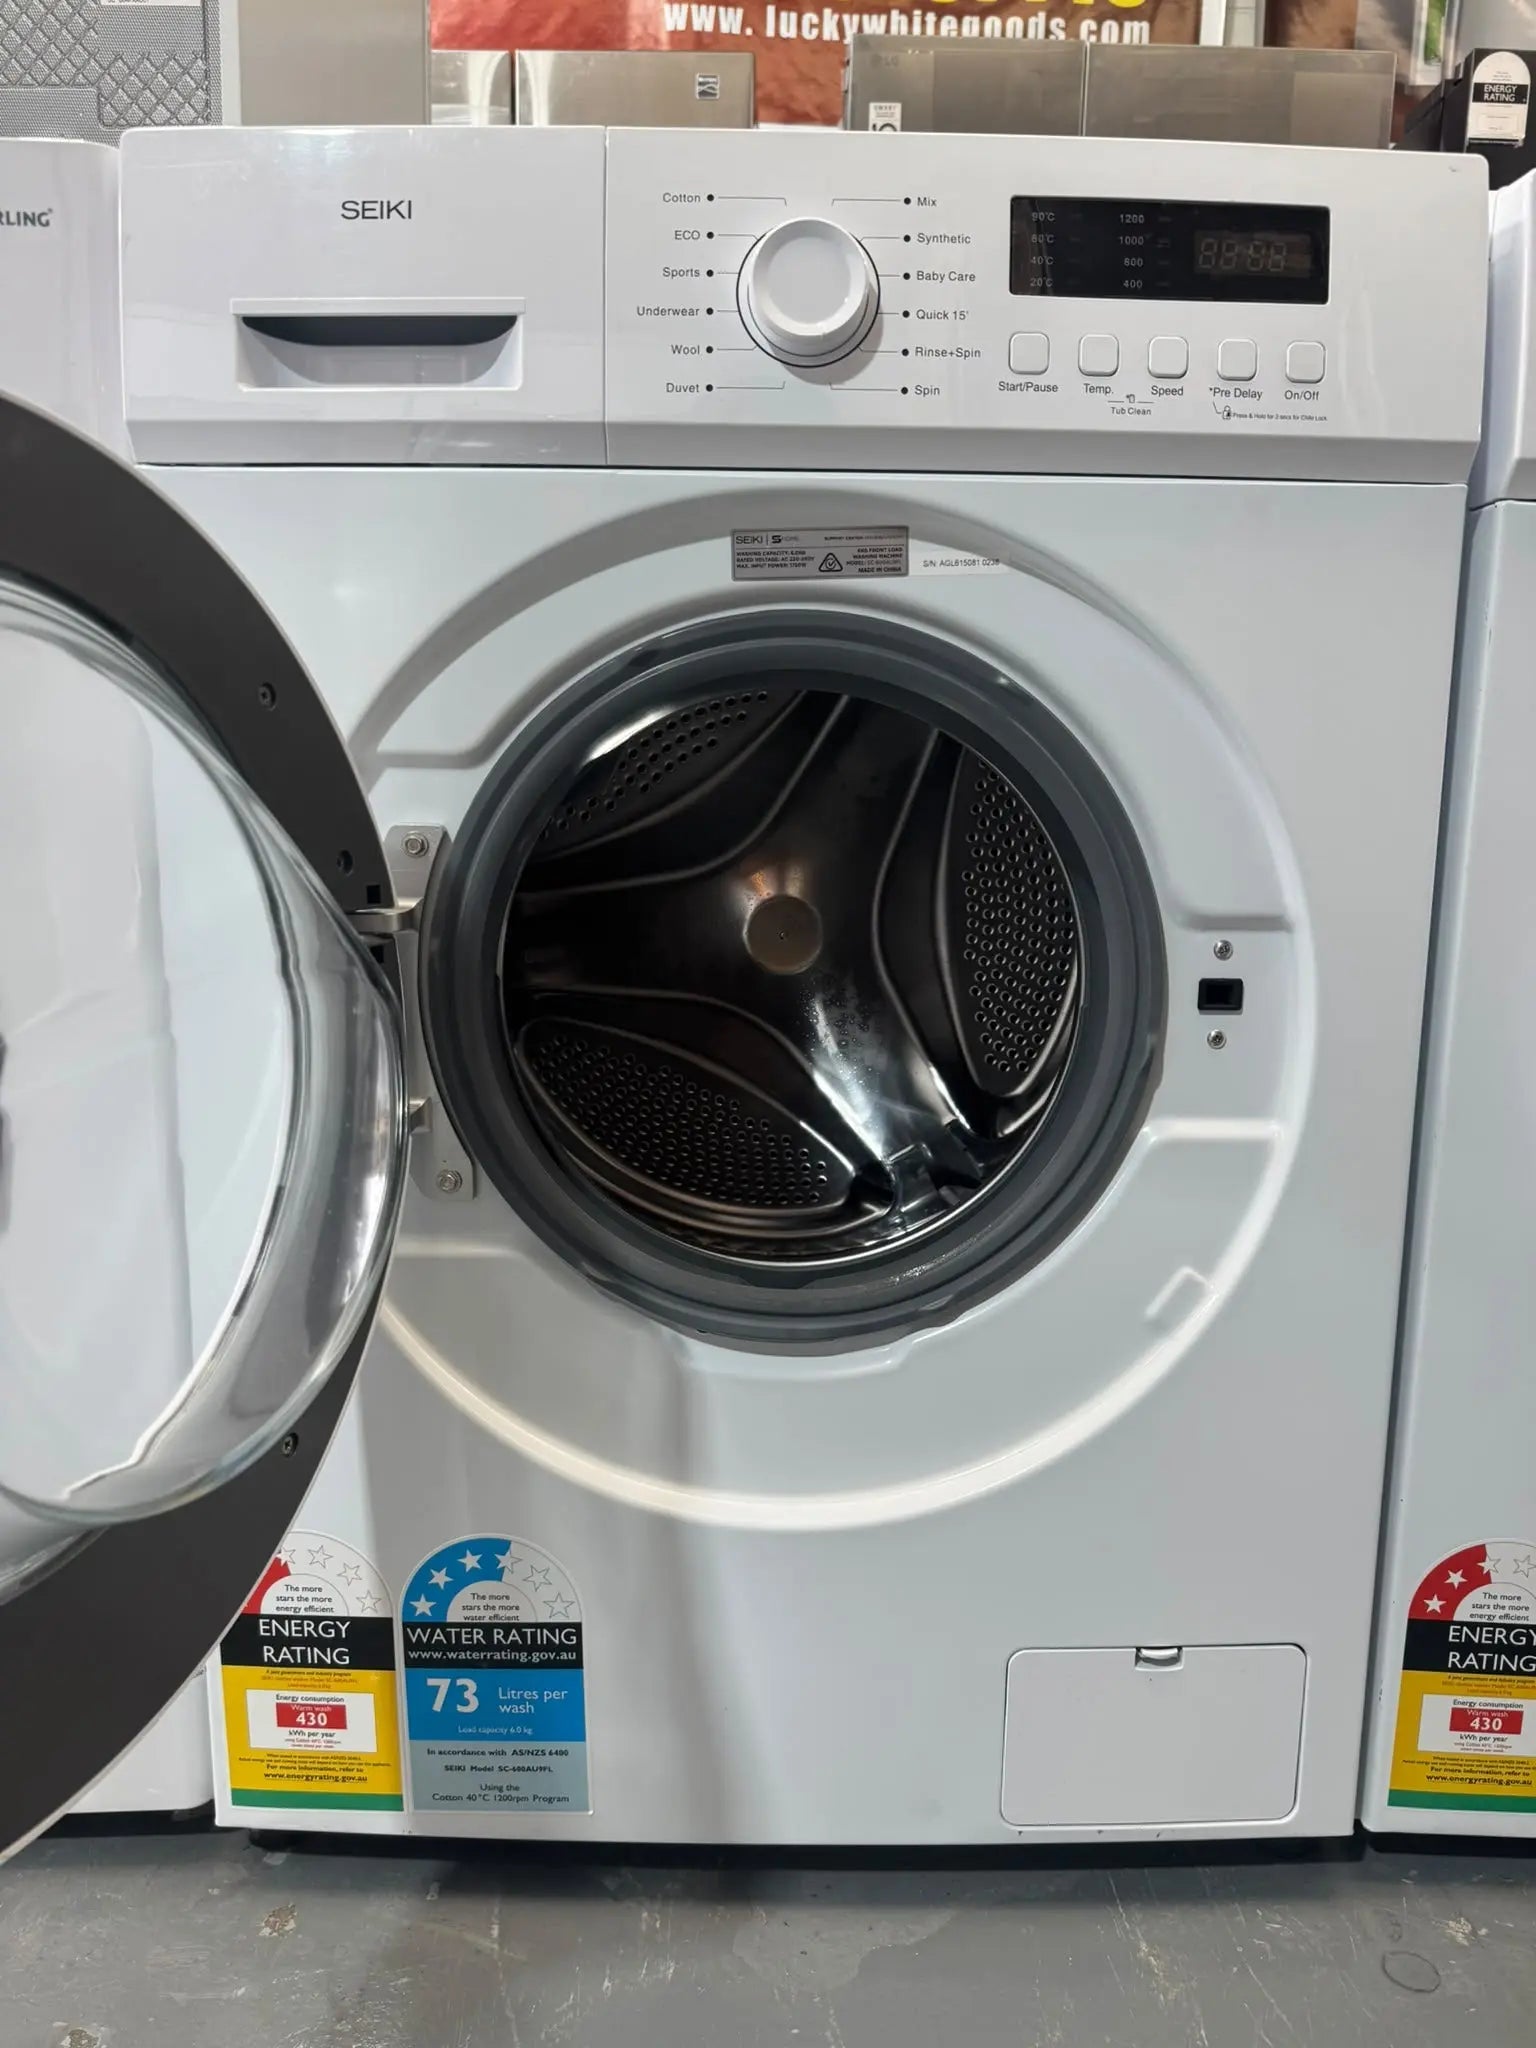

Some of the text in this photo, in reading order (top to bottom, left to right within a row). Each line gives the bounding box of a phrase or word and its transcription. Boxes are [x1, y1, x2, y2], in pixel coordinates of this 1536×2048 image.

[664, 3, 752, 36] www.
[1484, 85, 1517, 93] ENERGY
[1484, 93, 1515, 102] RATING
[662, 192, 701, 203] Cotton
[917, 197, 937, 207] Mix
[341, 200, 412, 220] SEIKI
[1120, 214, 1144, 224] 1200
[674, 230, 701, 240] ECO
[917, 232, 971, 245] Synthetic
[1119, 236, 1144, 245] 1000
[662, 267, 700, 279] Sports
[916, 270, 976, 283] Baby Care
[1123, 280, 1143, 289] 400
[636, 306, 700, 316] Underwear
[916, 309, 949, 320] Quick
[671, 344, 700, 355] Wool
[915, 346, 981, 360] Rinse+Spin
[666, 382, 700, 393] Duvet
[914, 384, 941, 397] Spin
[998, 381, 1059, 393] Start/Pause
[1083, 383, 1114, 395] Temp.
[1151, 385, 1184, 397] Speed
[1233, 388, 1263, 401] Delay
[1284, 390, 1320, 401] On/Off
[1111, 406, 1152, 416] Tub Clean
[736, 536, 763, 544] SEIKI
[285, 1584, 299, 1592] The
[1483, 1592, 1498, 1600] The
[276, 1605, 334, 1614] energy efficient
[1469, 1613, 1530, 1621] energy efficient
[259, 1619, 350, 1638] ENERGY
[407, 1627, 577, 1645] WATER RATING
[263, 1646, 350, 1665] RATING
[408, 1650, 577, 1663] www.waterrating.gov.au
[1447, 1651, 1536, 1672] RATING
[276, 1694, 345, 1703] Energy consumption
[426, 1678, 480, 1713] 73
[498, 1687, 568, 1702] Litres per
[499, 1701, 535, 1714] wash
[1453, 1699, 1524, 1709] Energy consumption
[296, 1712, 328, 1726] 430
[1470, 1717, 1502, 1731] 430
[511, 1749, 546, 1757] AS/NZS
[264, 1772, 368, 1783] www.energyrating.gov.au
[1426, 1774, 1533, 1786] www.energyrating.gov.au
[480, 1784, 503, 1792] Using
[432, 1793, 463, 1801] Cotton
[494, 1794, 528, 1803] 1200rpm
[532, 1794, 569, 1804] Program
